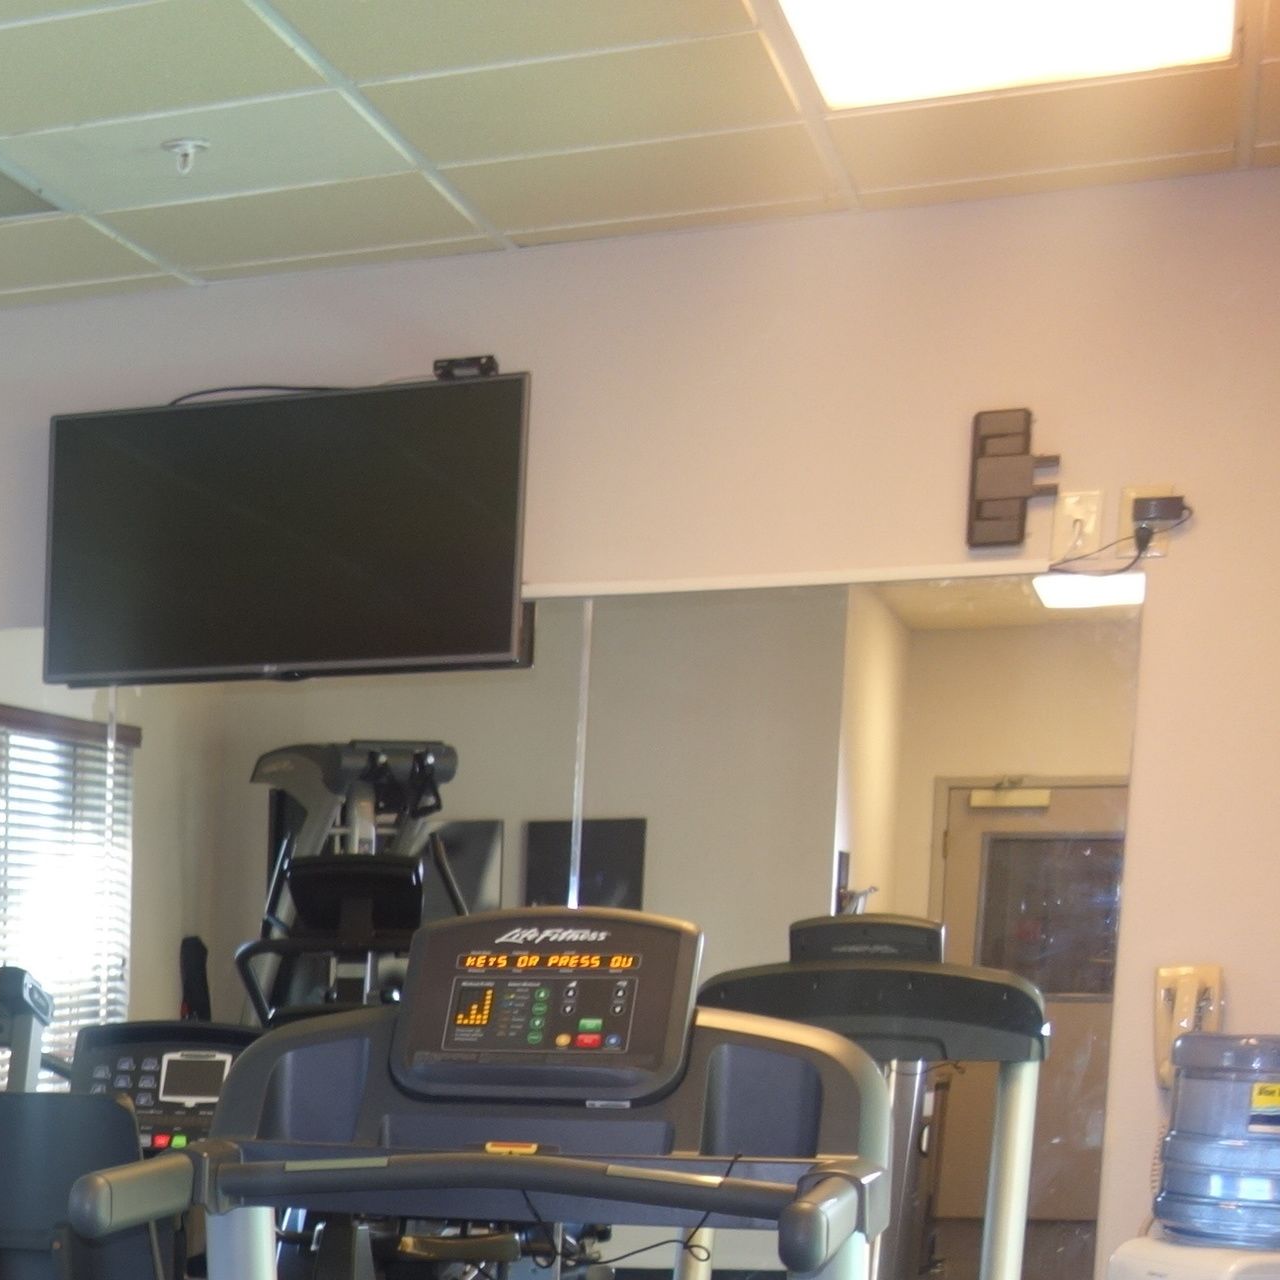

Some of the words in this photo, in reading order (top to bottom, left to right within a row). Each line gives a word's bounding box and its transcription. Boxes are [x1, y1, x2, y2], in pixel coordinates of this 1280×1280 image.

[465, 955, 508, 968] KEYS
[516, 955, 540, 968] OR
[546, 955, 601, 968] PRESS
